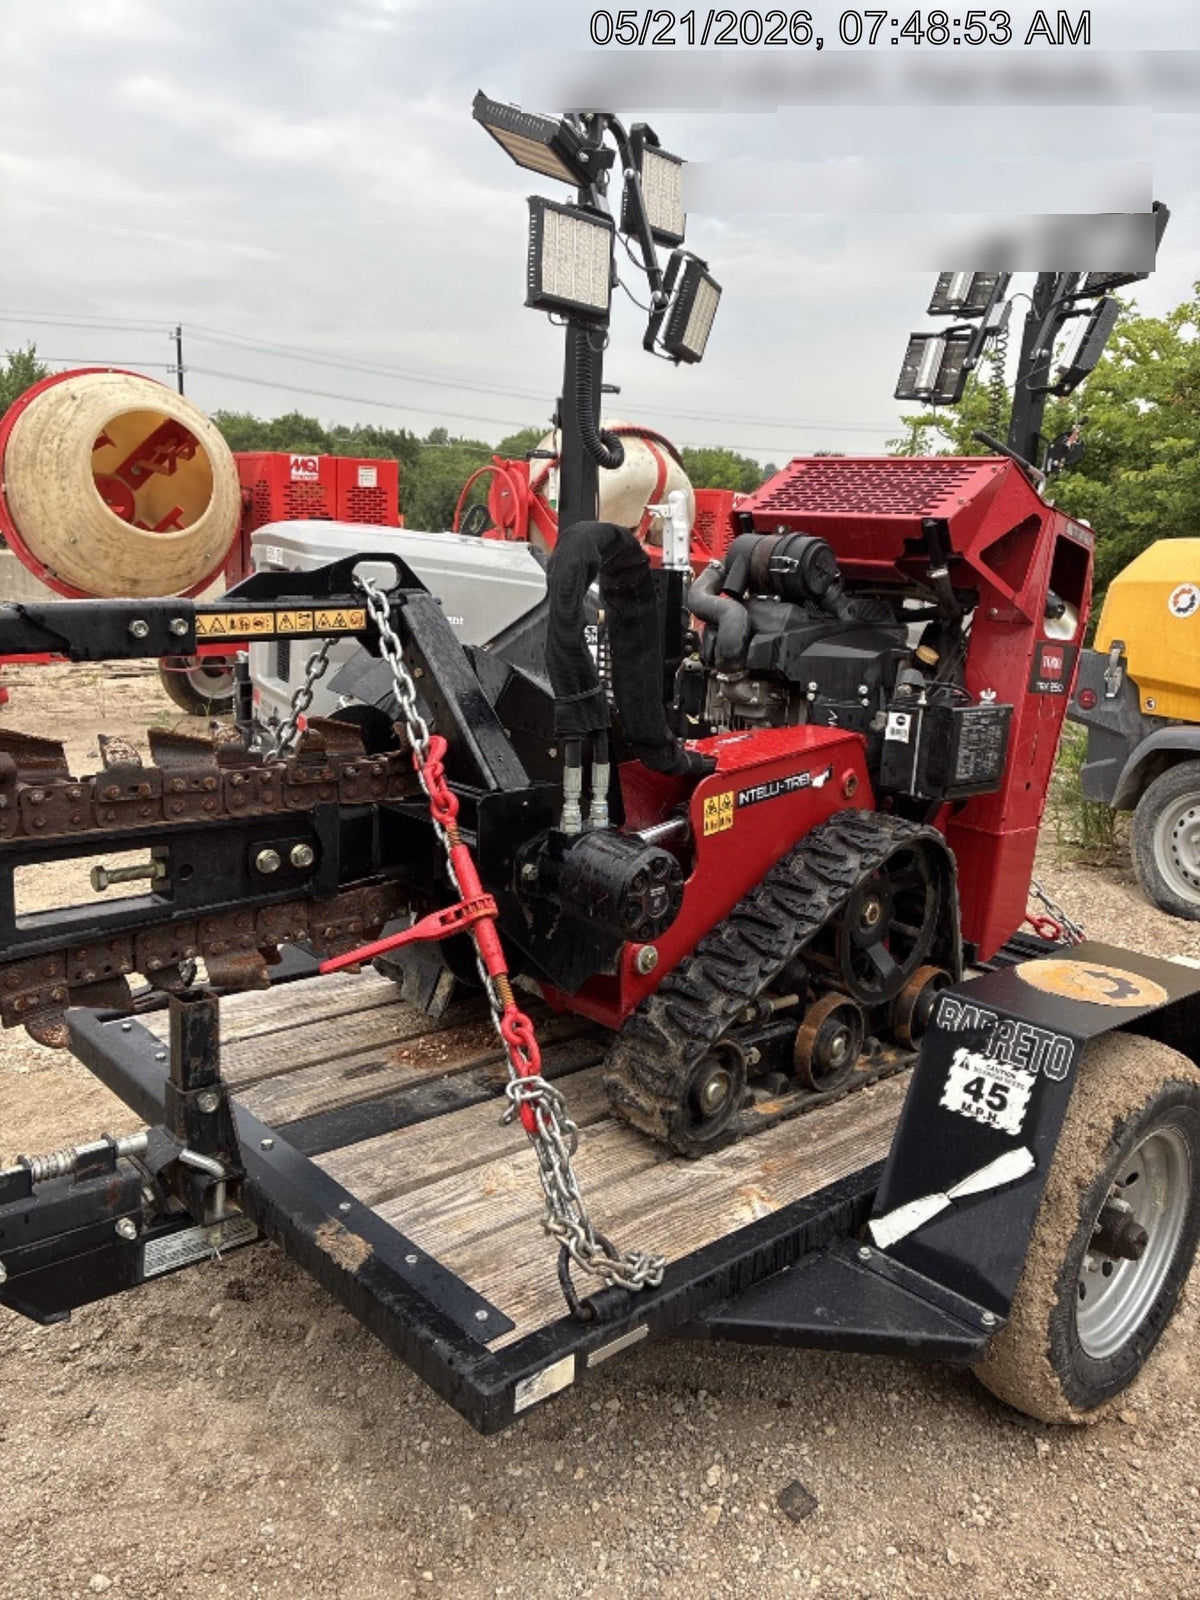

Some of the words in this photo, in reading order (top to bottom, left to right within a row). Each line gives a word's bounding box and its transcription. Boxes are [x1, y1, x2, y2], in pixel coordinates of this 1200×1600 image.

[290, 457, 319, 474] MQ
[963, 1076, 1010, 1112] 45
[961, 1101, 1001, 1125] M.P.H.
